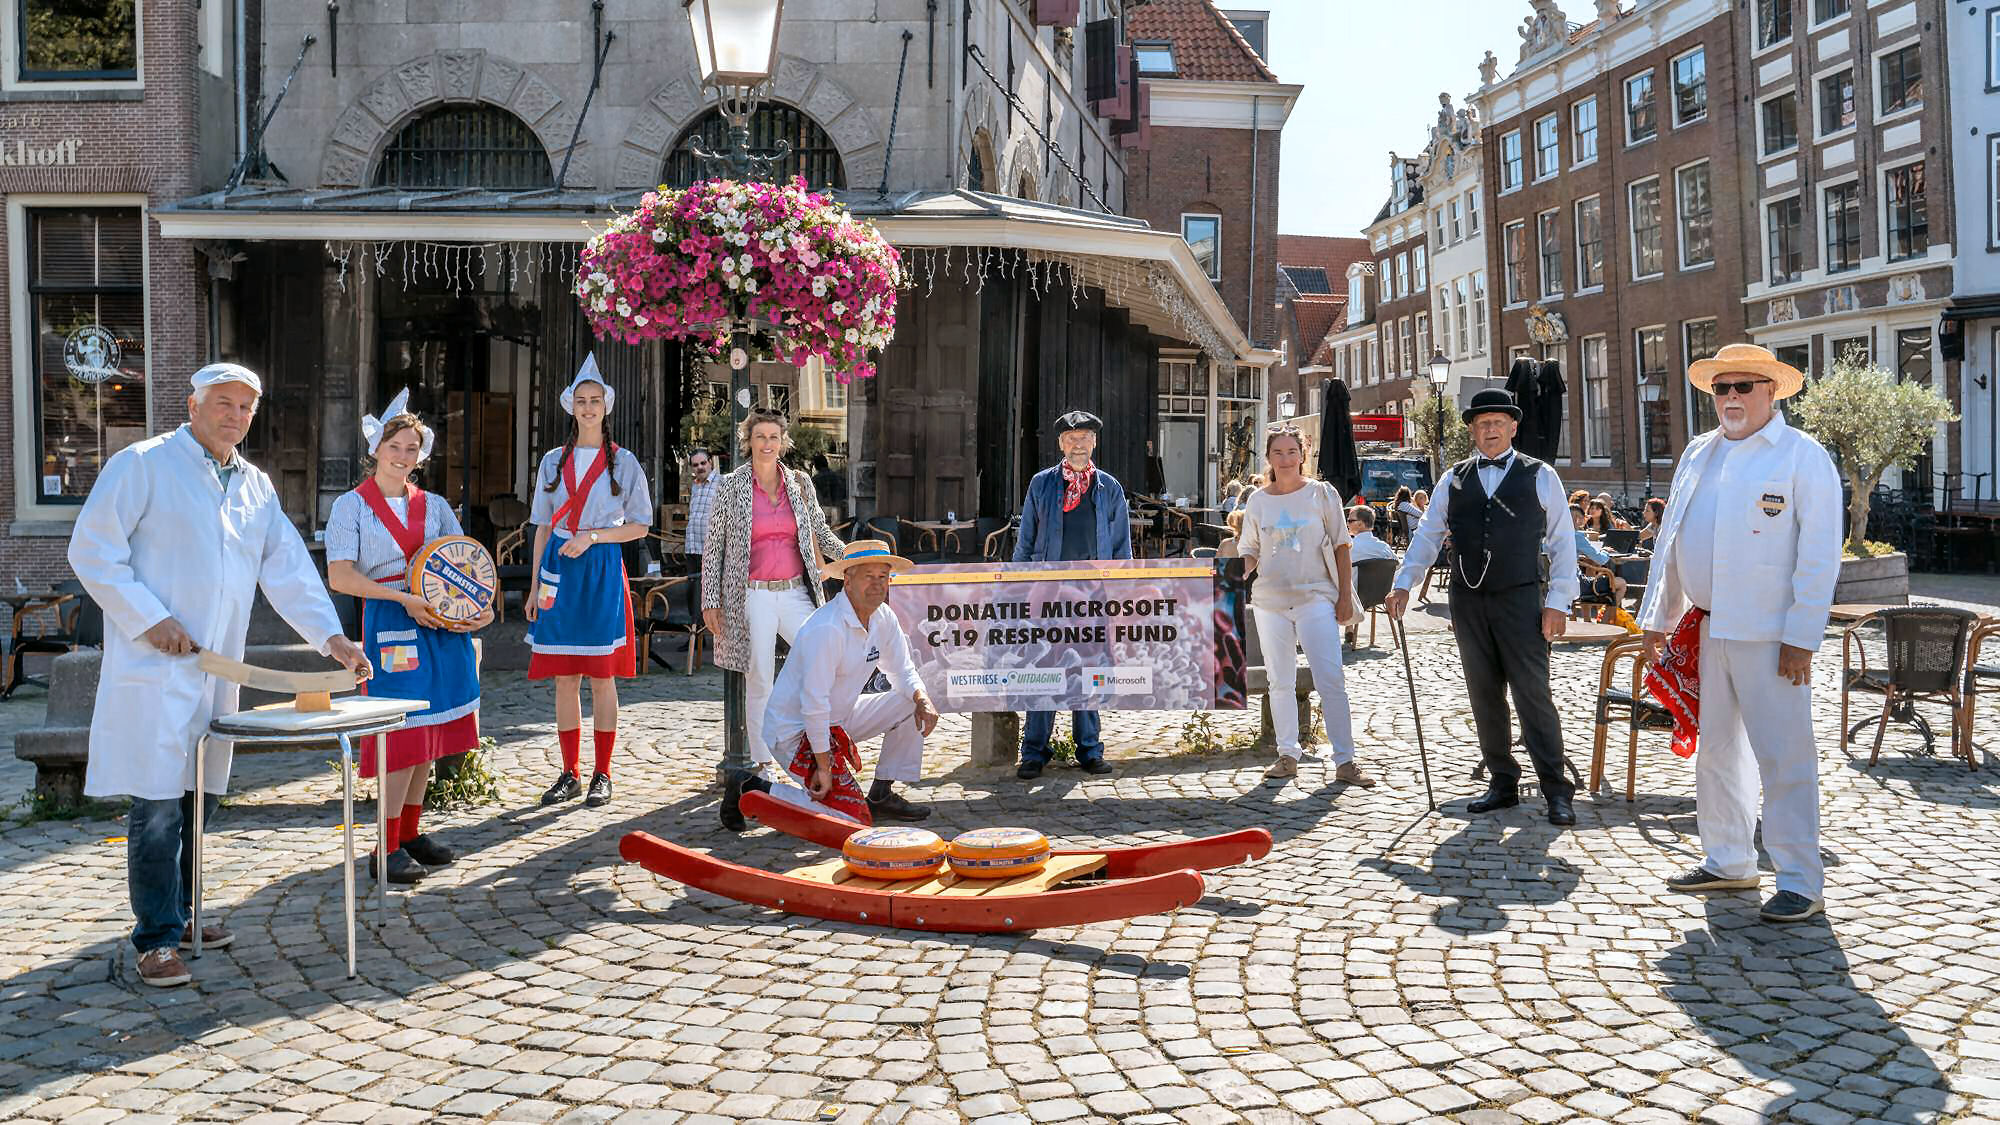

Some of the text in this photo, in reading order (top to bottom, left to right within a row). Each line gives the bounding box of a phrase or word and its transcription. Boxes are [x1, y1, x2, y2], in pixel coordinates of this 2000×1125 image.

[442, 565, 479, 596] BEEMSTER
[927, 599, 1178, 622] DONATIE MICROSOFT
[927, 625, 1178, 648] C-19 RESPONSE FUND
[950, 672, 1062, 686] WESTFRIESE UITDAGING
[1106, 675, 1147, 685] Microsoft
